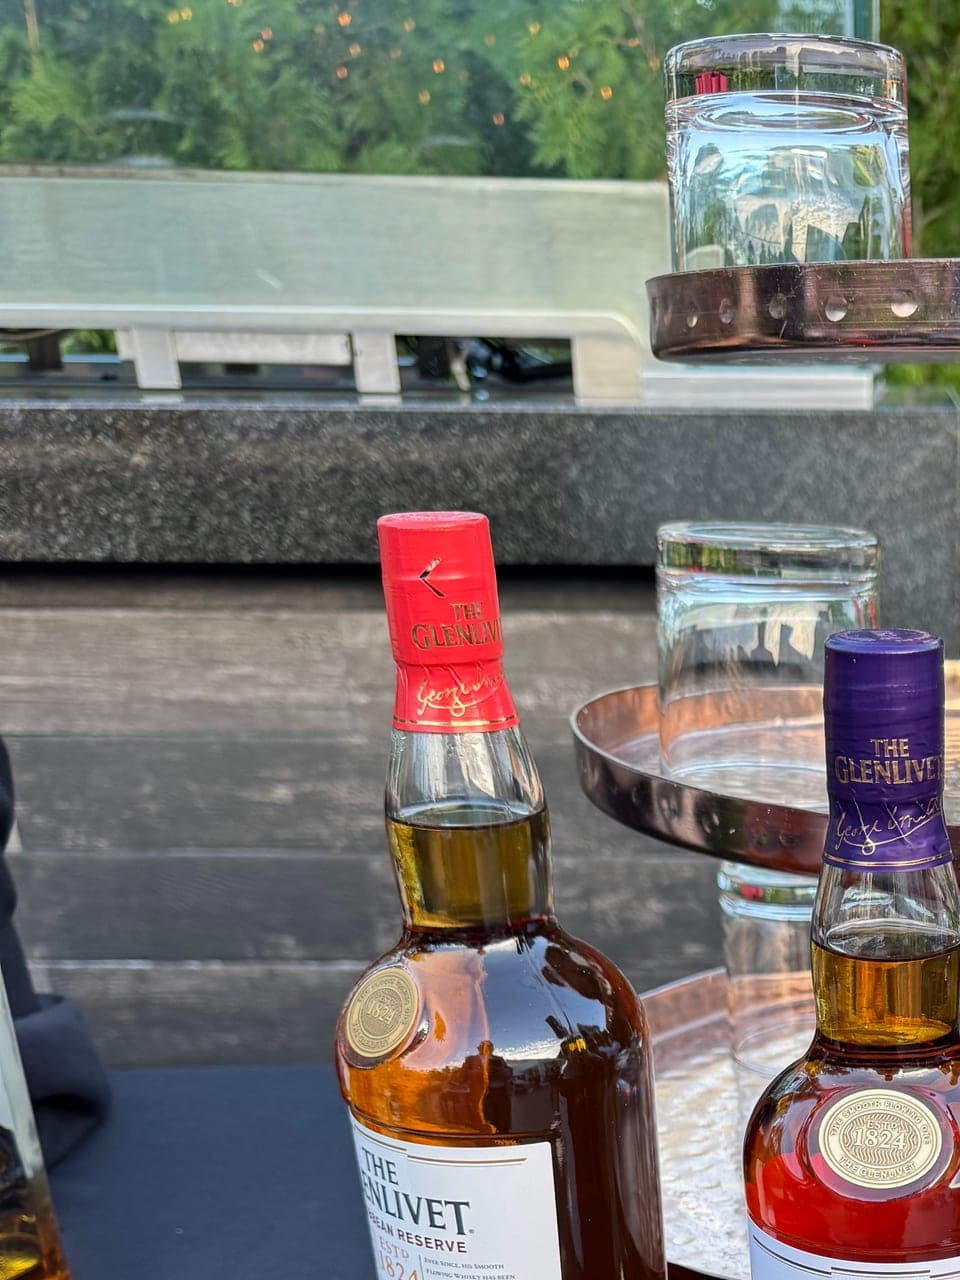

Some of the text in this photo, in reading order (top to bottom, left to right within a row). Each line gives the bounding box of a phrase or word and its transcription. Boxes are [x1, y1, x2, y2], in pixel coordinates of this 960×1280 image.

[411, 619, 503, 650] GLENLIV
[870, 738, 909, 758] THE
[853, 1127, 906, 1150] 1824
[361, 1146, 399, 1186] THE
[361, 1170, 471, 1236] ENLIVET
[397, 1228, 467, 1254] RESERVE
